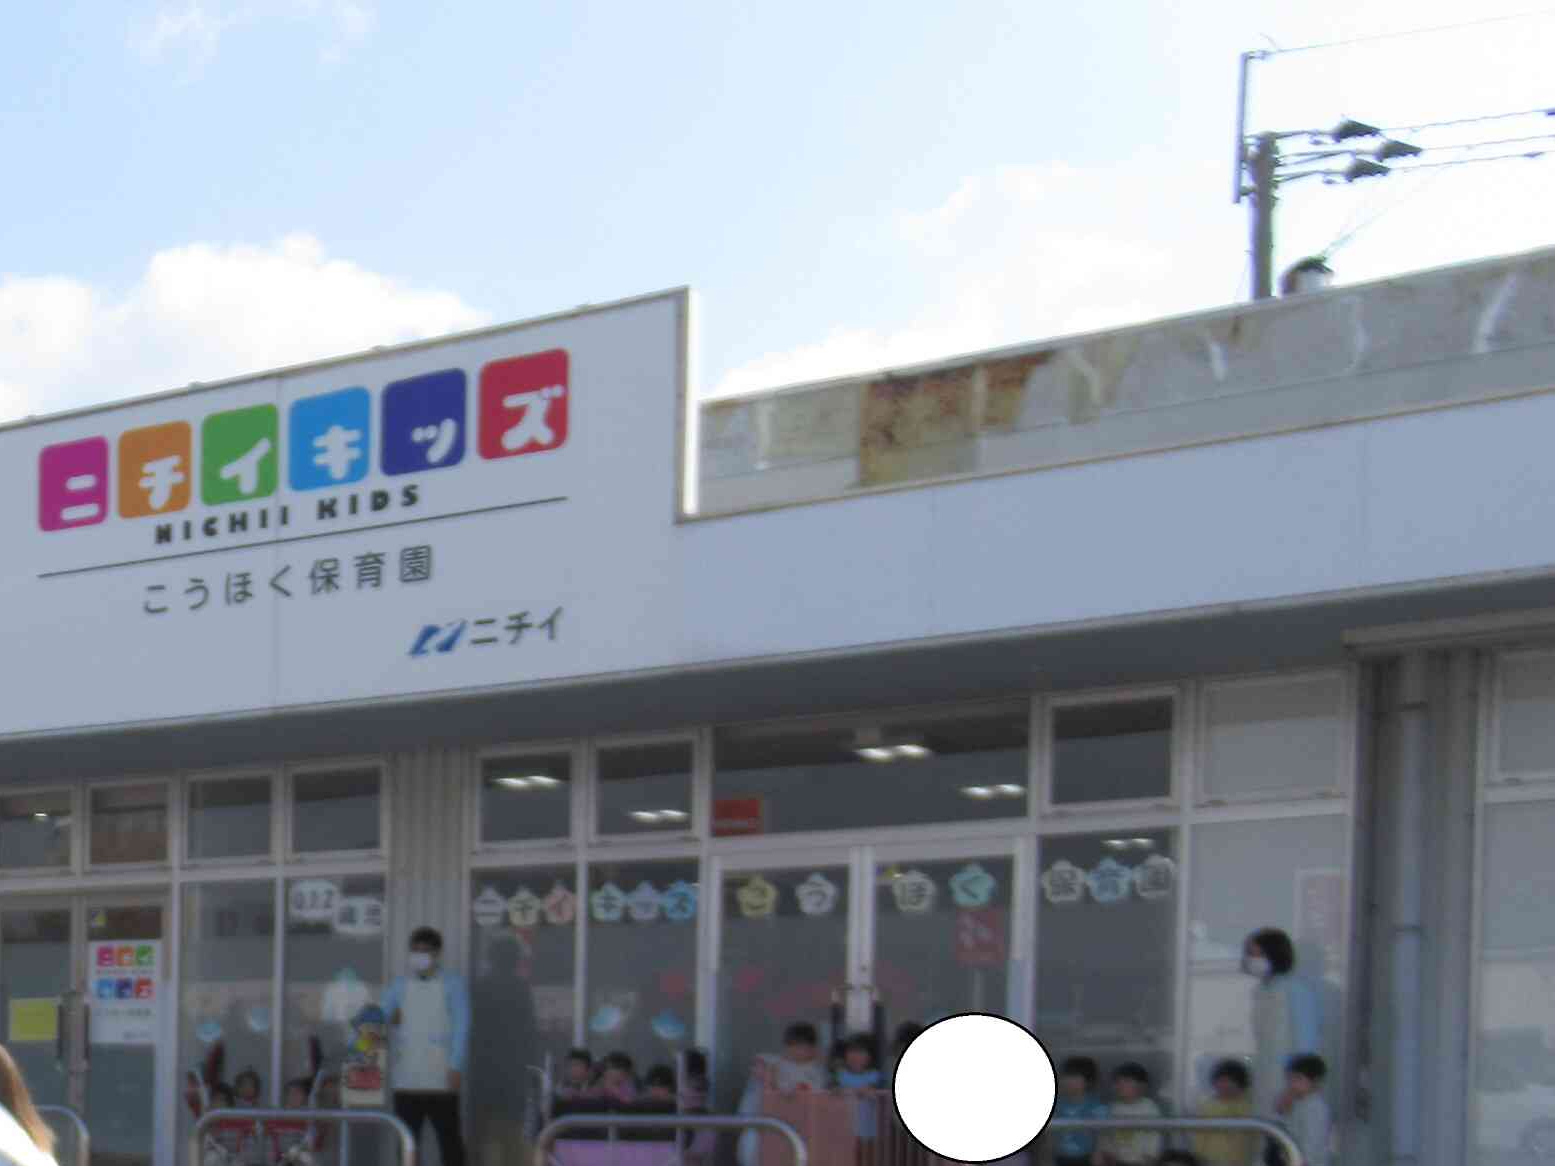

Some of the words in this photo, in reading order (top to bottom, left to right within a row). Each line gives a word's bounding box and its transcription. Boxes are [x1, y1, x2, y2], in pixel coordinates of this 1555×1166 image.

[56, 380, 565, 524] ニチイキッズ
[155, 505, 290, 545] NICHII
[316, 484, 421, 521] KIDS
[143, 544, 433, 615] こうほく保育園
[471, 606, 564, 647] ニチイ
